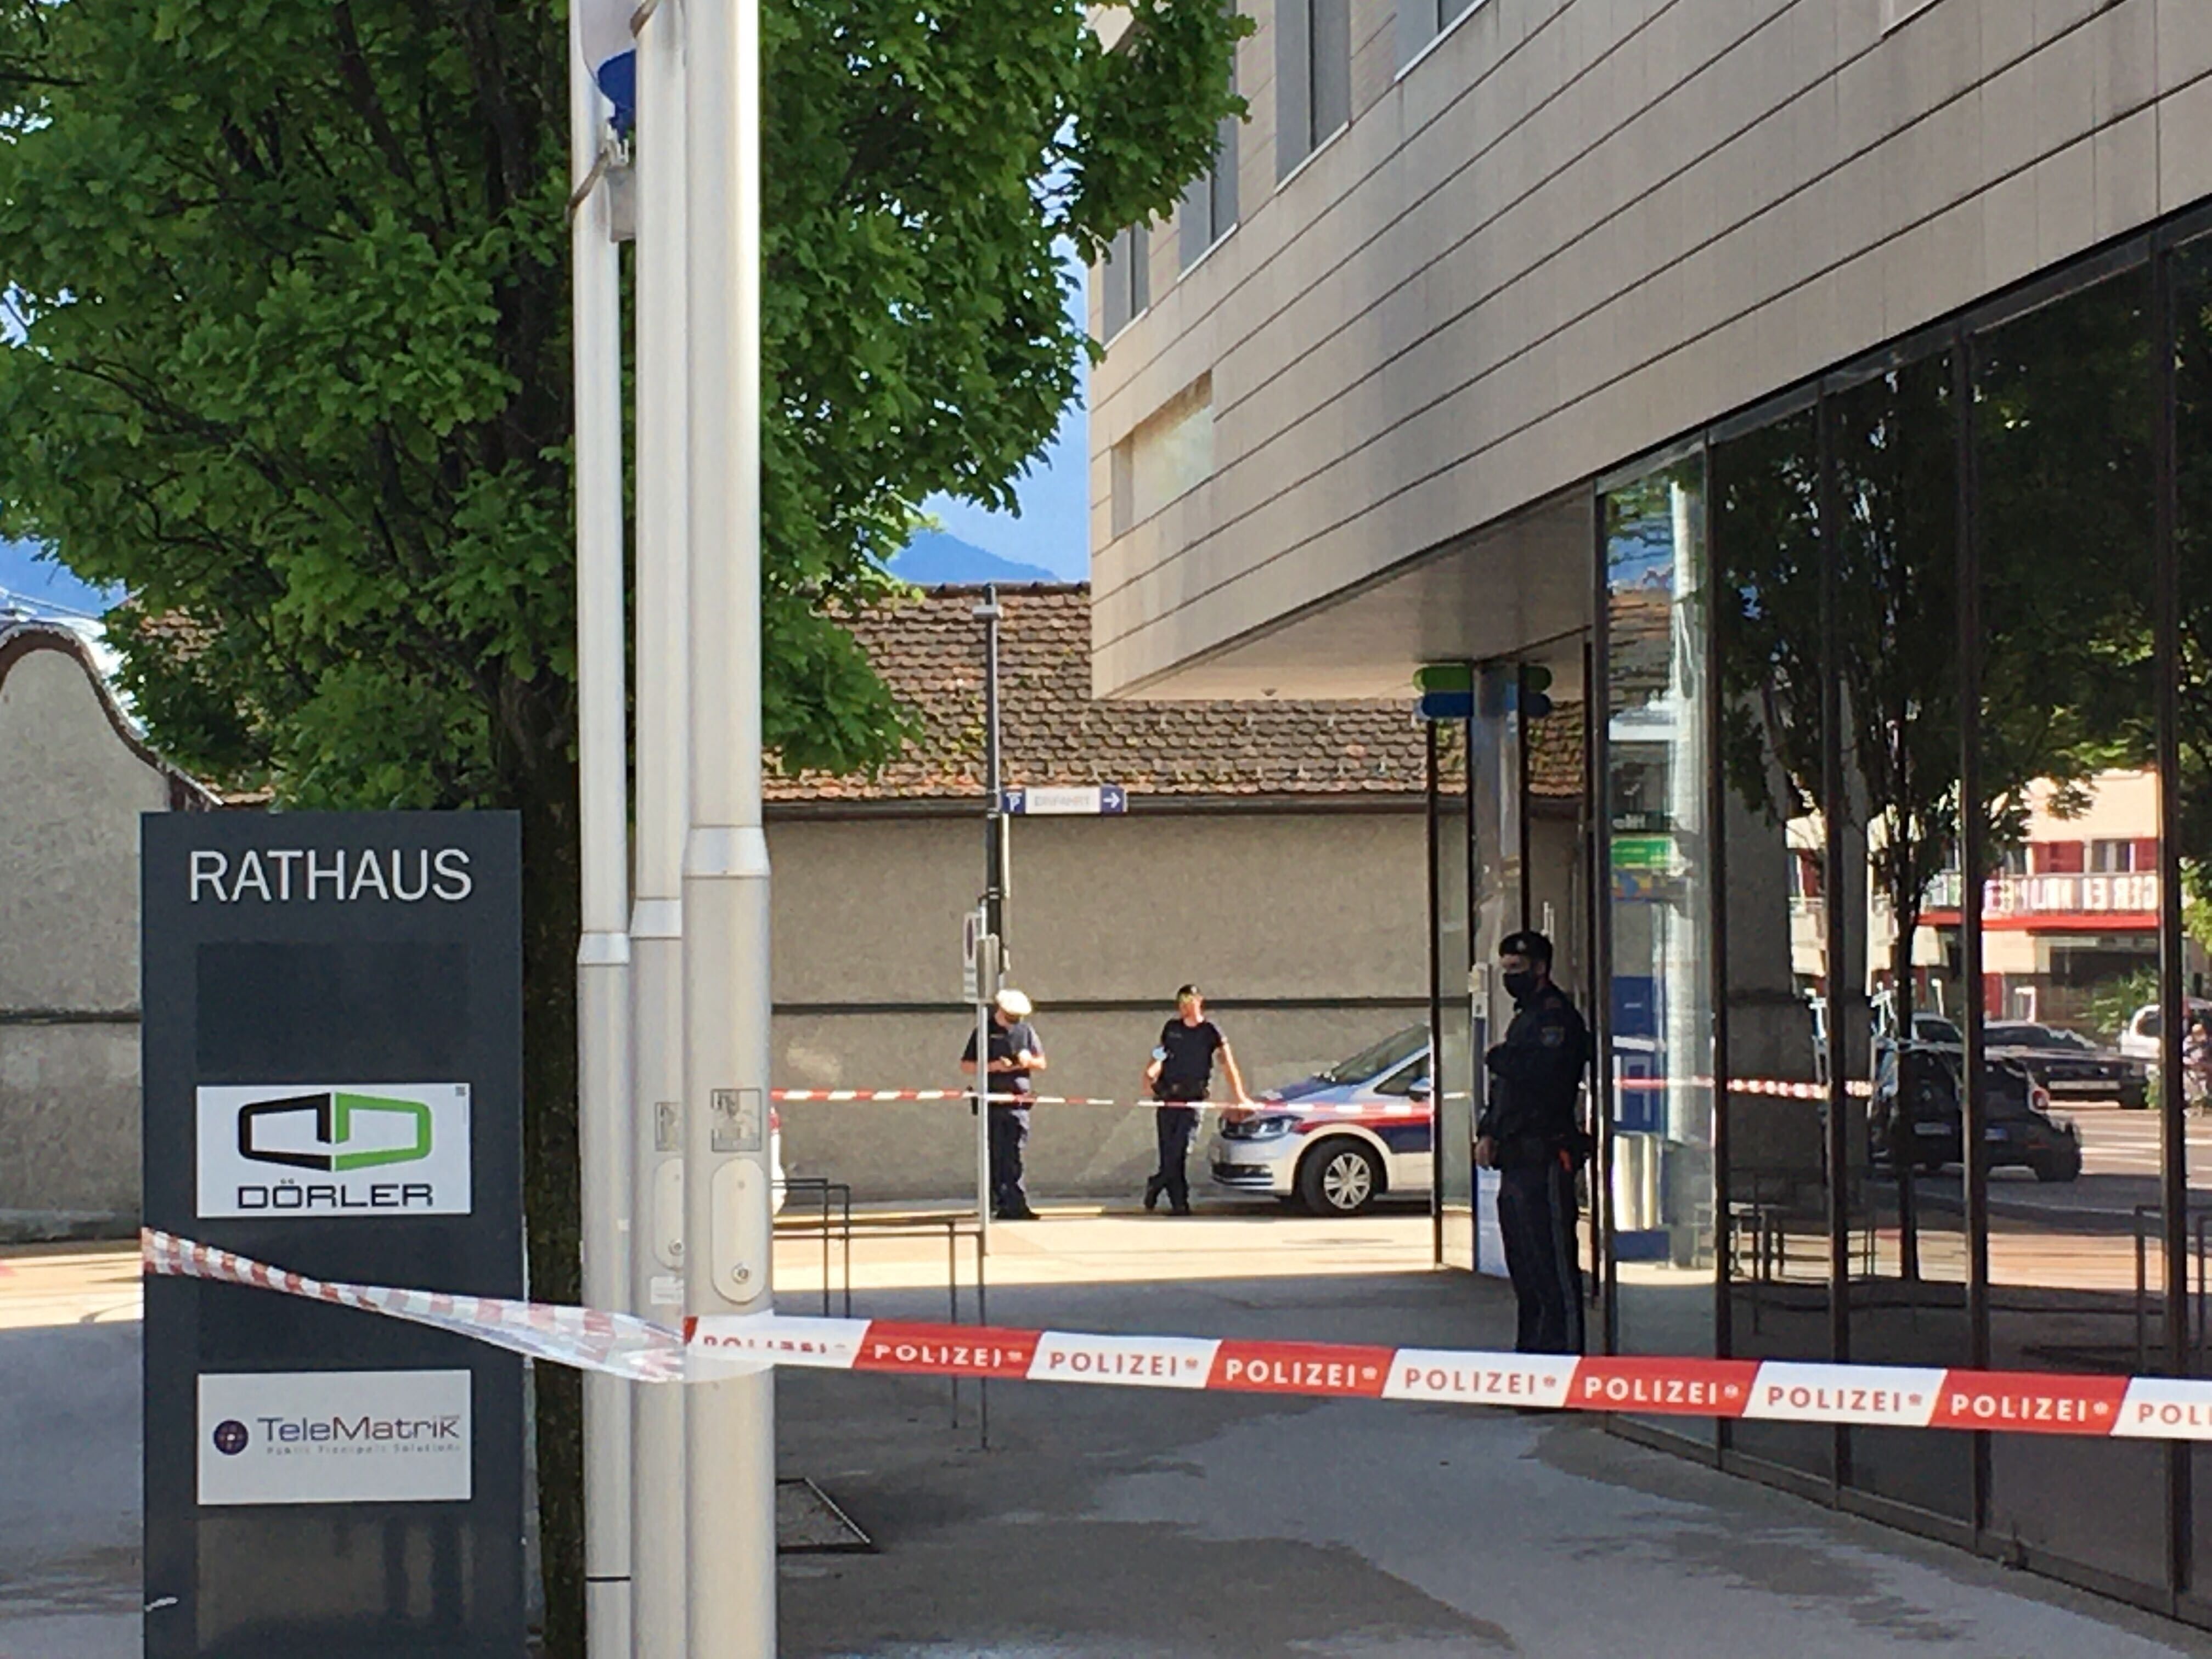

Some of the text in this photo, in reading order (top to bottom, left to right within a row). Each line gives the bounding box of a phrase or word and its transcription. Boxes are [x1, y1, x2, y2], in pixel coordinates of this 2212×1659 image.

[189, 849, 472, 901] RATHAUS
[238, 1179, 434, 1209] DÖRLER
[874, 1344, 1001, 1367] POLIZEI
[1049, 1351, 1177, 1376] POLIZEI
[1226, 1359, 1355, 1387] POLIZEI
[1405, 1369, 1534, 1395] POLIZEI
[1584, 1376, 1717, 1404] POLIZEI
[1767, 1386, 1900, 1412] POLIZEI
[1951, 1393, 2086, 1422] POLIZEI
[257, 1416, 460, 1442] TeleMatrik
